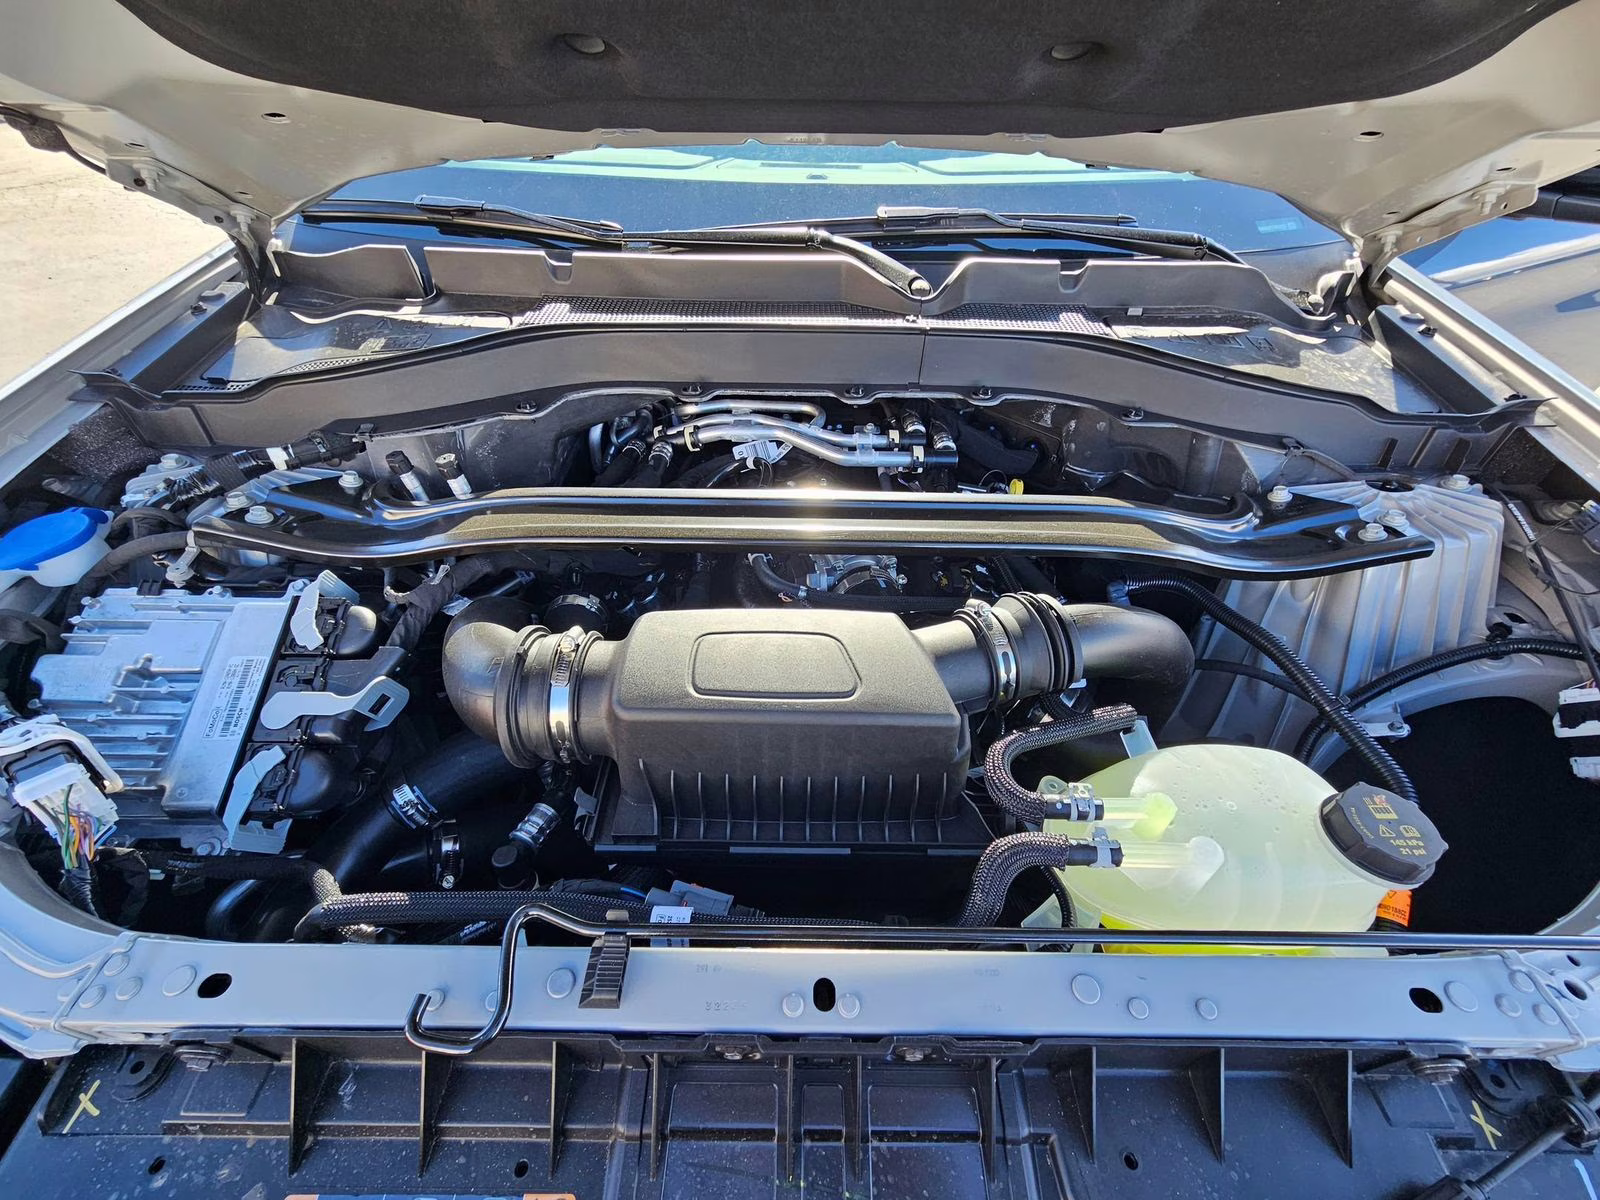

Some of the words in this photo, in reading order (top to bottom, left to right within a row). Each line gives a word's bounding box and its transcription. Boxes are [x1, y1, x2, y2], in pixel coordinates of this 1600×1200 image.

[205, 710, 220, 737] FoMoCo
[233, 707, 245, 728] BOSCH
[1400, 847, 1411, 855] 21
[1412, 847, 1427, 856] psi
